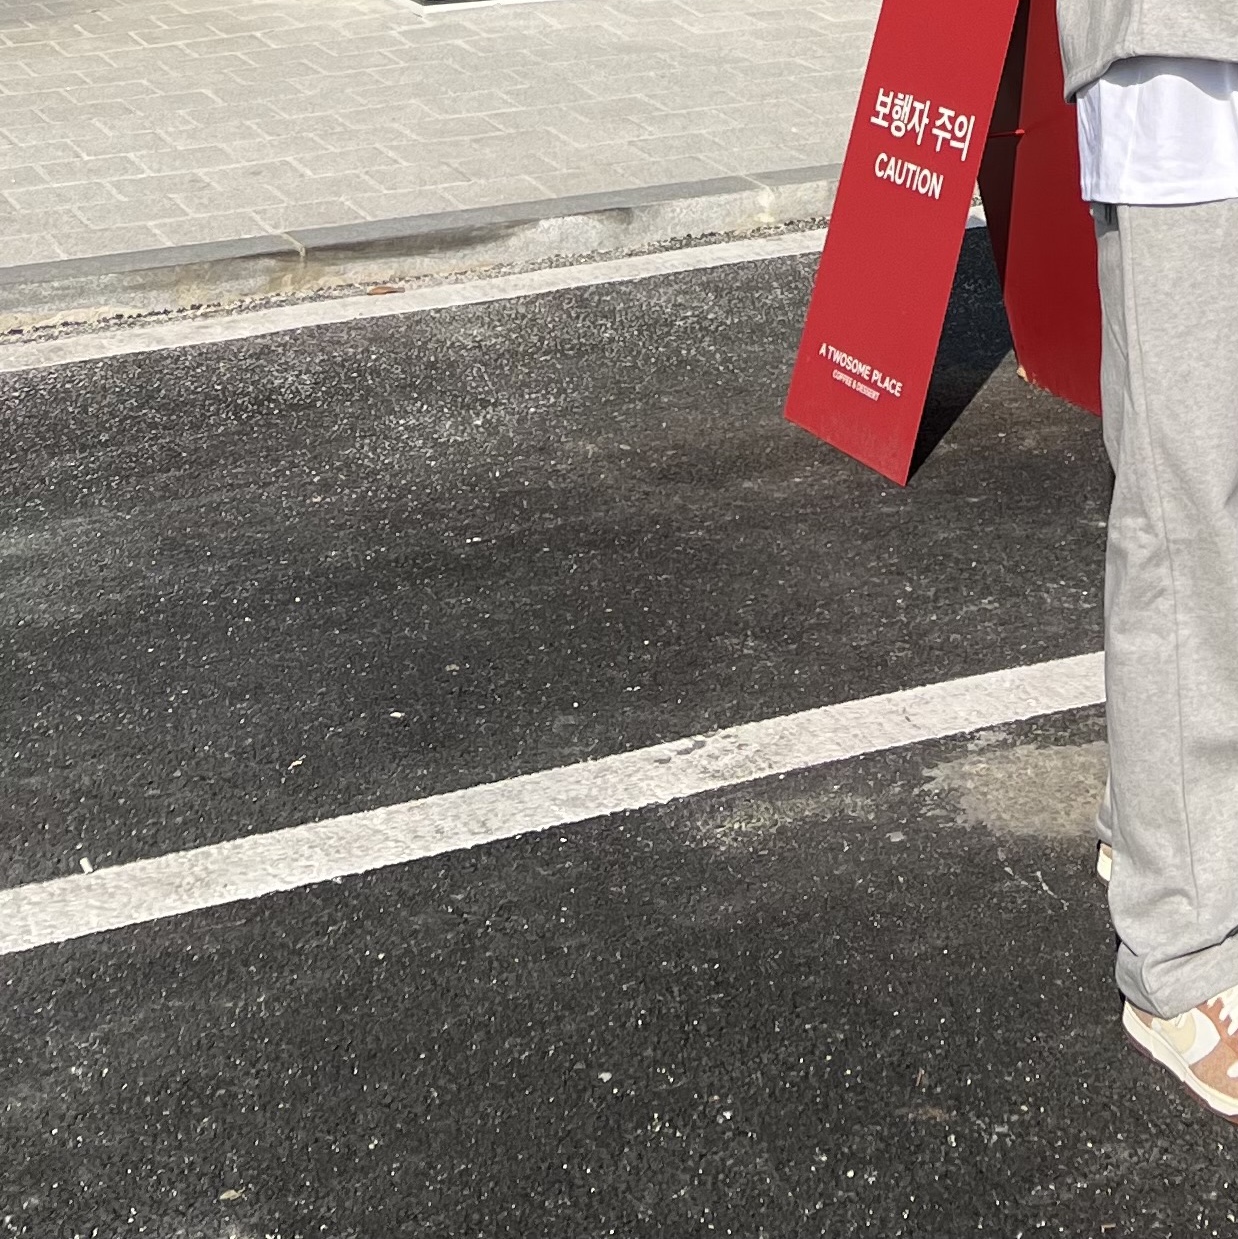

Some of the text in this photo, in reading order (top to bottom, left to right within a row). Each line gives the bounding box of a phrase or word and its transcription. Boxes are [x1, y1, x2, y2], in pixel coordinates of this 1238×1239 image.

[870, 87, 976, 162] 보행자 주의
[874, 152, 944, 200] CAUTION
[819, 342, 904, 399] A TWOSOME PLACE
